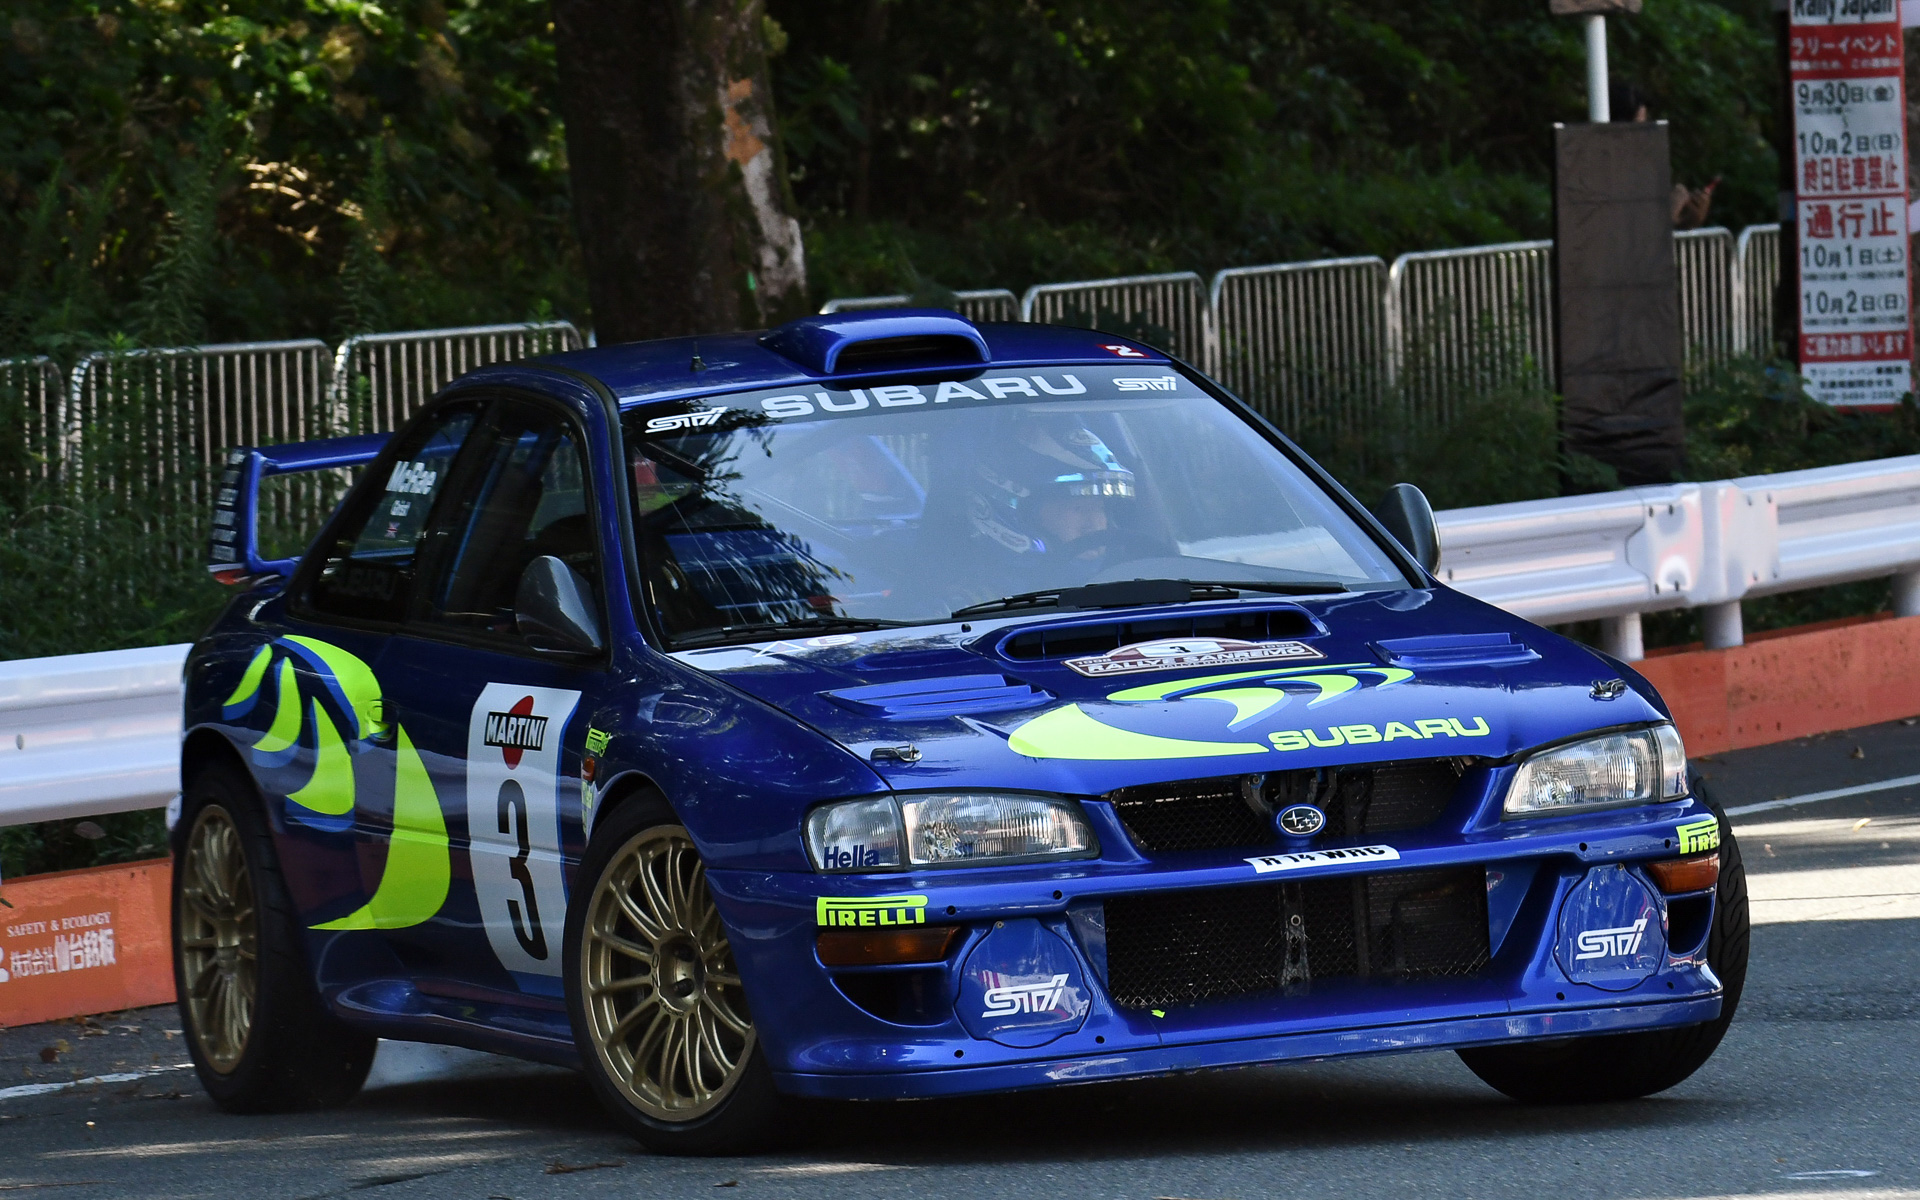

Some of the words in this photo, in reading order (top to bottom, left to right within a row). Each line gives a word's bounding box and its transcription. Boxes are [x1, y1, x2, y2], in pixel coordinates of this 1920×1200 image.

[1806, 200, 1897, 239] 通行止
[760, 374, 1088, 419] SUBARU
[1088, 656, 1175, 674] RALLYE
[1182, 646, 1307, 665] SANREMO
[486, 713, 546, 748] MARTINI
[1269, 716, 1490, 753] SUBARU
[823, 845, 880, 869] Hella
[1317, 846, 1386, 859] WRC
[497, 779, 548, 961] 3
[6, 921, 47, 937] SAFETY
[51, 919, 59, 932] &
[62, 911, 112, 930] ECOLOGY
[816, 895, 929, 926] PIRELLI
